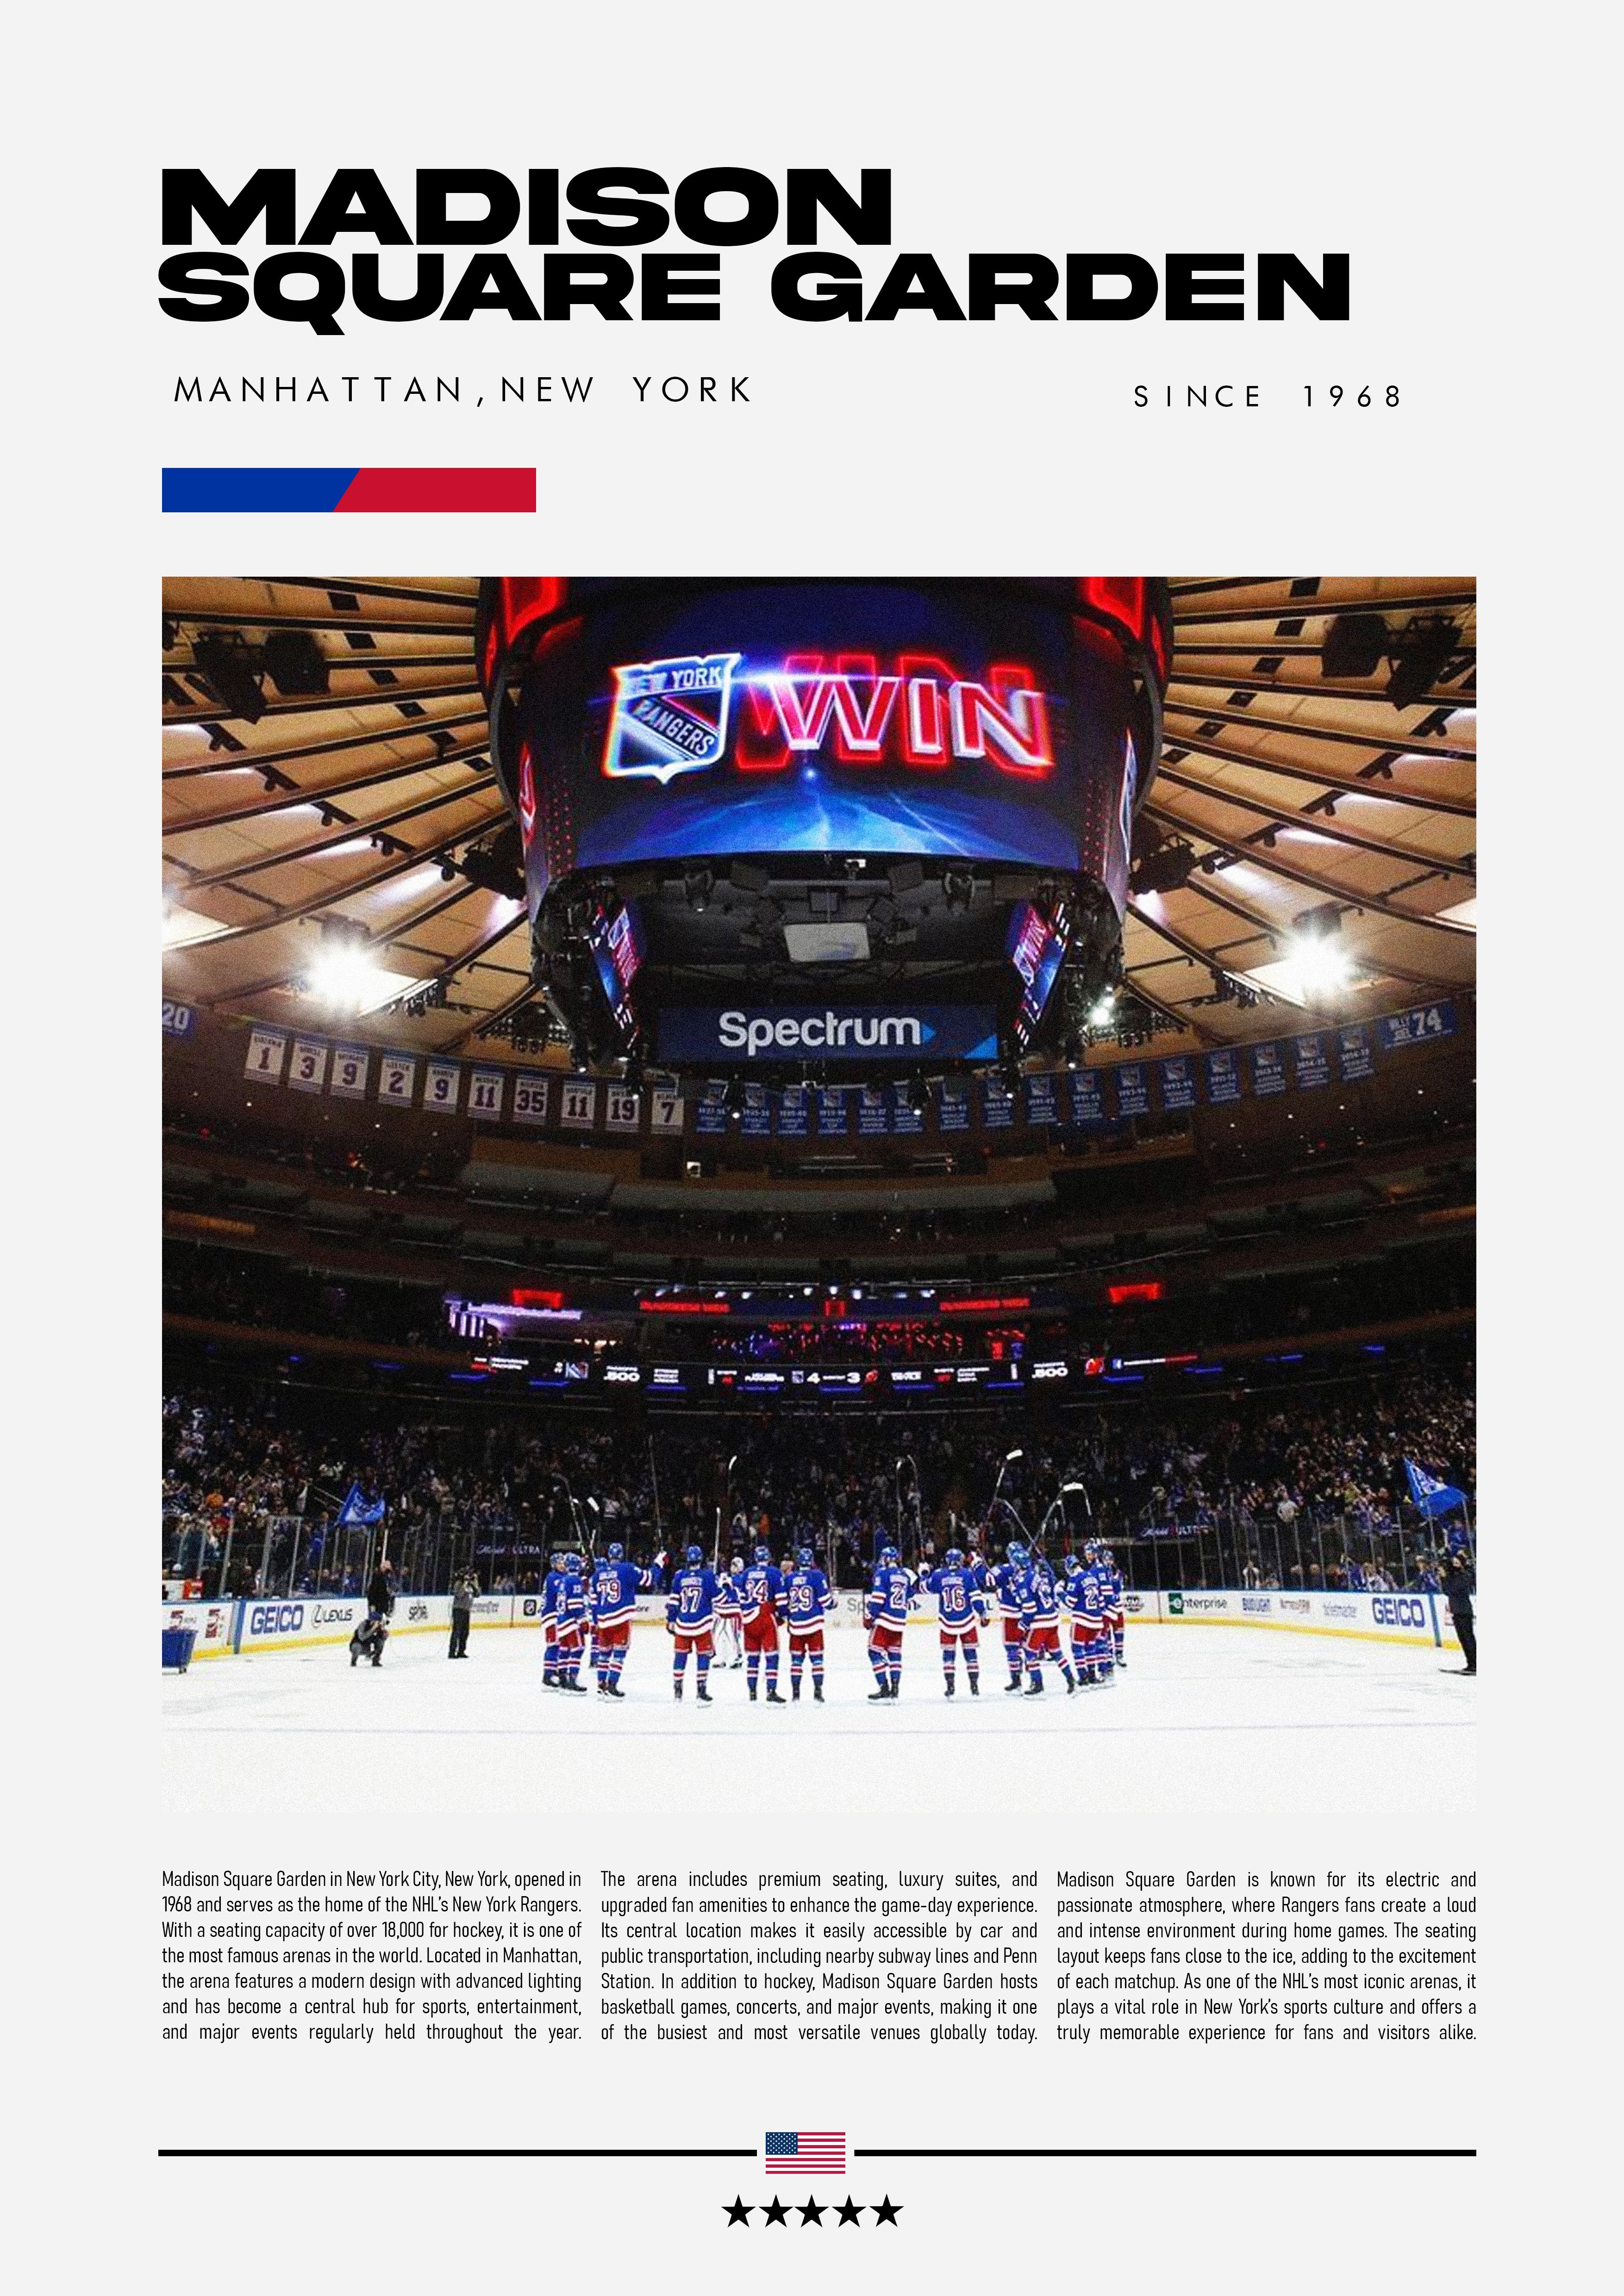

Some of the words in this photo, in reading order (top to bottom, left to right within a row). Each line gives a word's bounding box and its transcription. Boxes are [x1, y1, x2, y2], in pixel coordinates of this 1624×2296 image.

[162, 167, 891, 246] MADISON
[158, 252, 720, 335] SQUARE
[771, 252, 1349, 322] GARDEN
[633, 377, 750, 402] YORK
[1135, 386, 1258, 407] SINCE
[1304, 386, 1399, 407] 1968
[672, 666, 720, 689] YORK
[633, 698, 715, 755] RANGERS
[766, 675, 1054, 766] WIN
[719, 1011, 921, 1056] Spectrum
[1412, 1008, 1443, 1036] 74
[259, 1046, 270, 1071] 1
[300, 1055, 316, 1080] 3
[342, 1063, 357, 1086] 9
[388, 1070, 405, 1094] 2
[434, 1078, 449, 1100] 9
[475, 1085, 495, 1108] 11
[516, 1089, 545, 1113] 35
[568, 1094, 589, 1118] 11
[610, 1097, 636, 1120] 19
[661, 1101, 675, 1123] 7
[807, 1372, 820, 1384] 4
[847, 1372, 861, 1383] 3
[680, 1587, 703, 1613] 17
[942, 1586, 965, 1612] 16
[250, 1604, 304, 1635] GEICO
[1372, 1597, 1425, 1628] GEICO
[162, 1870, 219, 1886] Madison
[224, 1870, 272, 1891] Square
[277, 1870, 325, 1886] Garden
[331, 1871, 342, 1886] in
[347, 1870, 376, 1886] New
[379, 1870, 410, 1886] York
[413, 1870, 441, 1891] City,
[445, 1870, 474, 1886] New
[477, 1870, 511, 1889] York,
[515, 1870, 564, 1891] opened
[569, 1871, 581, 1886] in
[600, 1870, 625, 1886] The
[637, 1874, 676, 1886] arena
[689, 1870, 747, 1886] includes
[759, 1871, 820, 1891] premium
[832, 1871, 887, 1891] seating,
[899, 1871, 944, 1891] luxury
[955, 1871, 1000, 1889] suites,
[1012, 1870, 1037, 1886] and
[1057, 1871, 1113, 1887] Madison
[1126, 1871, 1174, 1891] Square
[1187, 1871, 1235, 1887] Garden
[1248, 1872, 1259, 1887] is
[1270, 1871, 1315, 1887] known
[1327, 1871, 1346, 1887] for
[1358, 1872, 1374, 1887] its
[1386, 1871, 1439, 1887] electric
[1451, 1871, 1476, 1887] and
[601, 1896, 667, 1917] upgraded
[672, 1897, 693, 1912] fan
[699, 1897, 767, 1912] amenities
[772, 1898, 785, 1912] to
[790, 1896, 849, 1912] enhance
[854, 1896, 876, 1912] the
[882, 1897, 952, 1917] game-day
[957, 1897, 1037, 1916] experience.
[1057, 1897, 1132, 1916] passionate
[1139, 1896, 1225, 1917] atmosphere,
[1231, 1896, 1275, 1912] where
[1282, 1896, 1339, 1916] Rangers
[1345, 1897, 1375, 1912] fans
[1381, 1898, 1426, 1912] create
[1433, 1901, 1440, 1912] a
[1448, 1897, 1476, 1912] loud
[162, 1921, 192, 1937] With
[197, 1926, 205, 1937] a
[210, 1922, 261, 1941] seating
[266, 1922, 325, 1942] capacity
[330, 1922, 343, 1937] of
[347, 1925, 377, 1937] over
[382, 1921, 424, 1940] 18,000
[429, 1922, 449, 1937] for
[453, 1921, 504, 1942] hockey,
[510, 1922, 518, 1937] it
[524, 1922, 534, 1937] is
[539, 1925, 563, 1937] one
[568, 1922, 582, 1937] of
[602, 1922, 618, 1938] Its
[627, 1922, 677, 1938] central
[687, 1922, 741, 1938] location
[750, 1922, 796, 1938] makes
[806, 1923, 815, 1938] it
[824, 1922, 865, 1942] easily
[874, 1922, 947, 1938] accessible
[956, 1922, 972, 1942] by
[981, 1926, 1003, 1938] car
[1012, 1922, 1037, 1938] and
[1057, 1947, 1099, 1968] layout
[1105, 1947, 1145, 1968] keeps
[1150, 1948, 1180, 1963] fans
[1186, 1948, 1222, 1963] close
[1227, 1948, 1240, 1963] to
[1245, 1948, 1267, 1963] the
[1273, 1948, 1296, 1966] ice,
[1301, 1948, 1347, 1967] adding
[1353, 1948, 1366, 1963] to
[1371, 1948, 1393, 1963] the
[1399, 1948, 1476, 1963] excitement
[162, 1972, 184, 1988] the
[190, 1977, 229, 1988] arena
[235, 1972, 293, 1988] features
[299, 1977, 306, 1988] a
[312, 1972, 364, 1988] modern
[370, 1972, 415, 1992] design
[420, 1972, 450, 1988] with
[456, 1972, 523, 1988] advanced
[528, 1972, 581, 1992] lighting
[601, 2024, 614, 2040] of
[624, 2023, 647, 2040] the
[658, 2024, 707, 2040] busiest
[718, 2024, 743, 2040] and
[754, 2025, 788, 2040] most
[798, 2023, 860, 2040] versatile
[870, 2028, 920, 2040] venues
[931, 2023, 987, 2044] globally
[997, 2023, 1037, 2044] today.
[1057, 2023, 1091, 2044] truly
[1100, 2023, 1179, 2040] memorable
[1189, 2024, 1265, 2044] experience
[1275, 2024, 1294, 2040] for
[1304, 2024, 1333, 2040] fans
[1343, 2023, 1368, 2040] and
[1378, 2024, 1430, 2040] visitors
[1439, 2023, 1476, 2040] alike.
